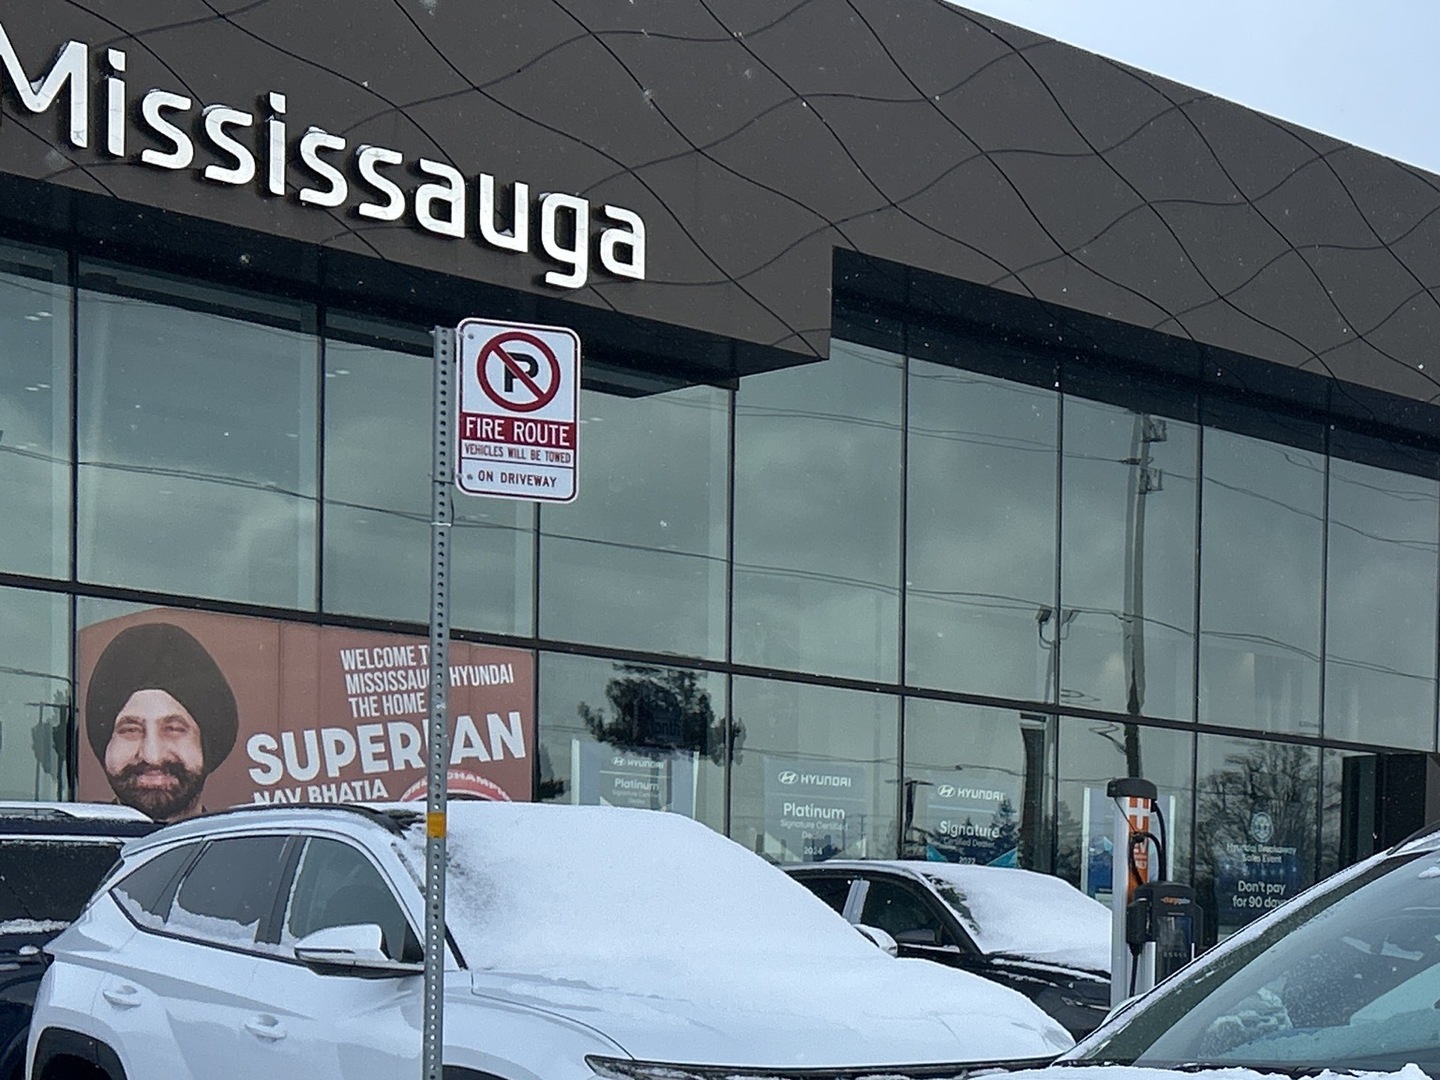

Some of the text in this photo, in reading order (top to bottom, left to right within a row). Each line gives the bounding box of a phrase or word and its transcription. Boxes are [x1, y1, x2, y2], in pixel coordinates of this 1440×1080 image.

[0, 22, 646, 288] Mississauga
[465, 416, 570, 446] FIRE ROUTE
[464, 443, 571, 464] VEHICLES WILL BE TOWED
[478, 469, 557, 488] ON DRIVEWAY
[340, 645, 430, 671] WELCOME T
[344, 663, 514, 695] MISSISSAU HYUNDAI
[348, 692, 427, 718] THE HOME
[246, 711, 527, 786] SUPERAN
[614, 778, 659, 791] Platinum
[801, 774, 851, 787] HYUNDAI
[307, 778, 389, 803] BHATIA
[957, 787, 1005, 801] HYUNDAI
[784, 802, 845, 820] Platinum
[780, 819, 815, 829] Signature
[940, 820, 1001, 838] Signature
[1238, 880, 1286, 895] Don't pay
[1232, 895, 1247, 907] for
[1248, 896, 1263, 908] 90
